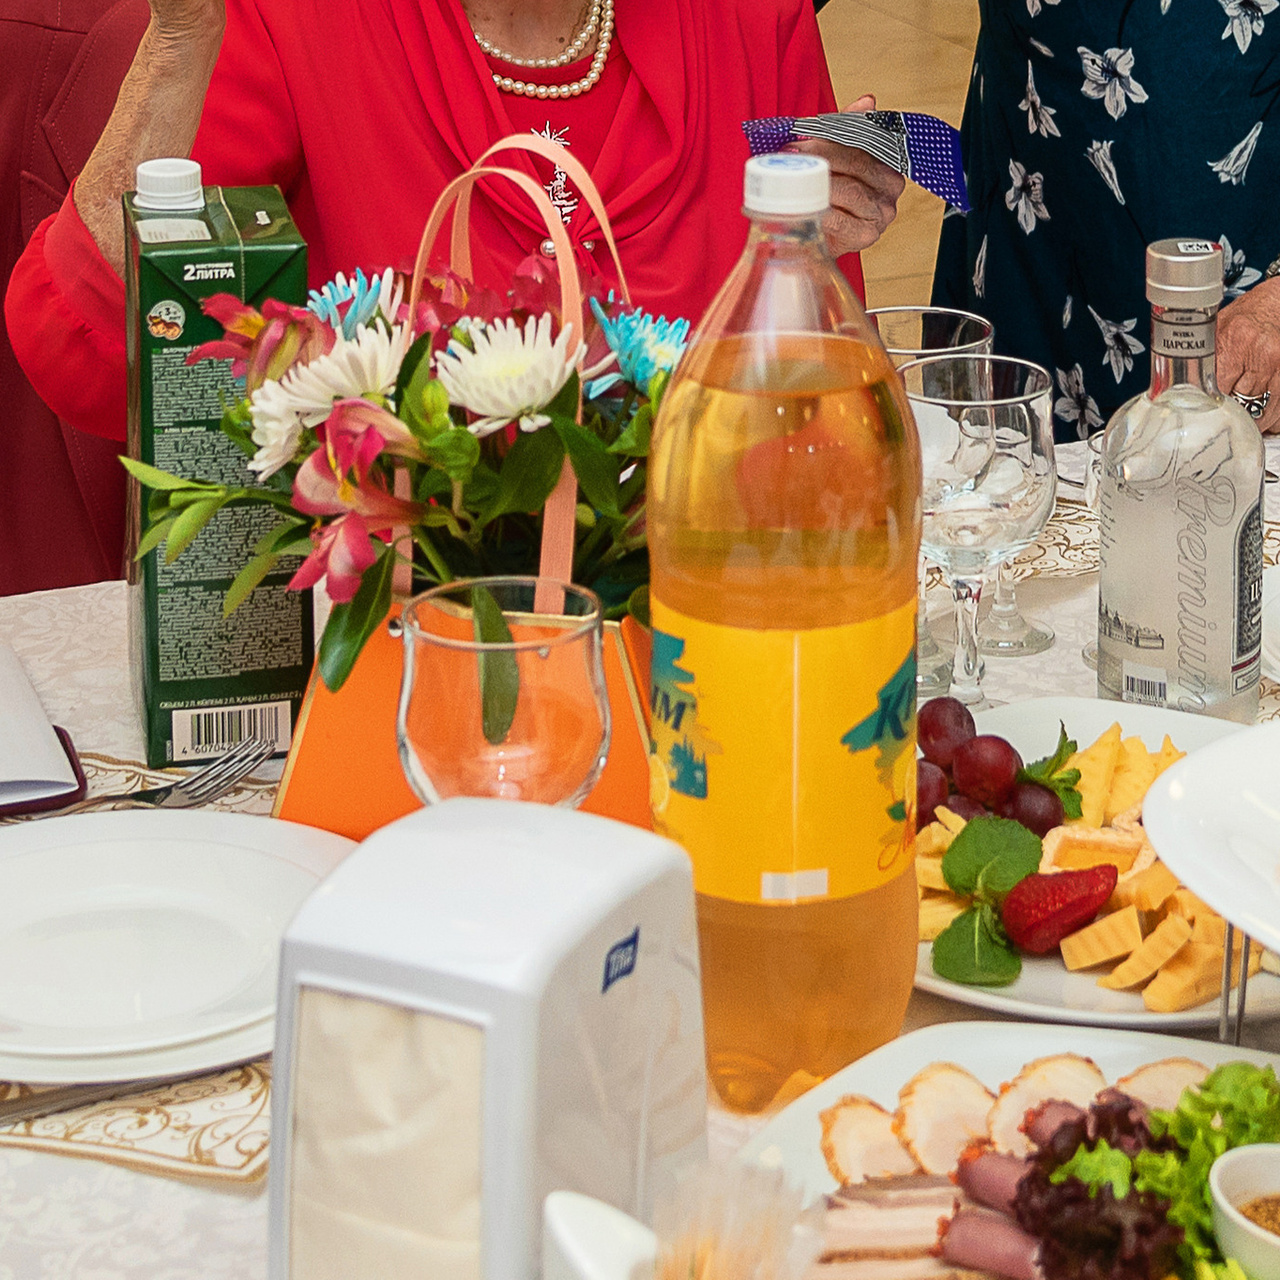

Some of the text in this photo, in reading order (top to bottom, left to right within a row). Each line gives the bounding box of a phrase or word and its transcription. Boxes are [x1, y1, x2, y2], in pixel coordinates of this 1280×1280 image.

[183, 263, 236, 281] 2 ЛИТРА
[1162, 338, 1206, 350] ЦАРСКАЯ
